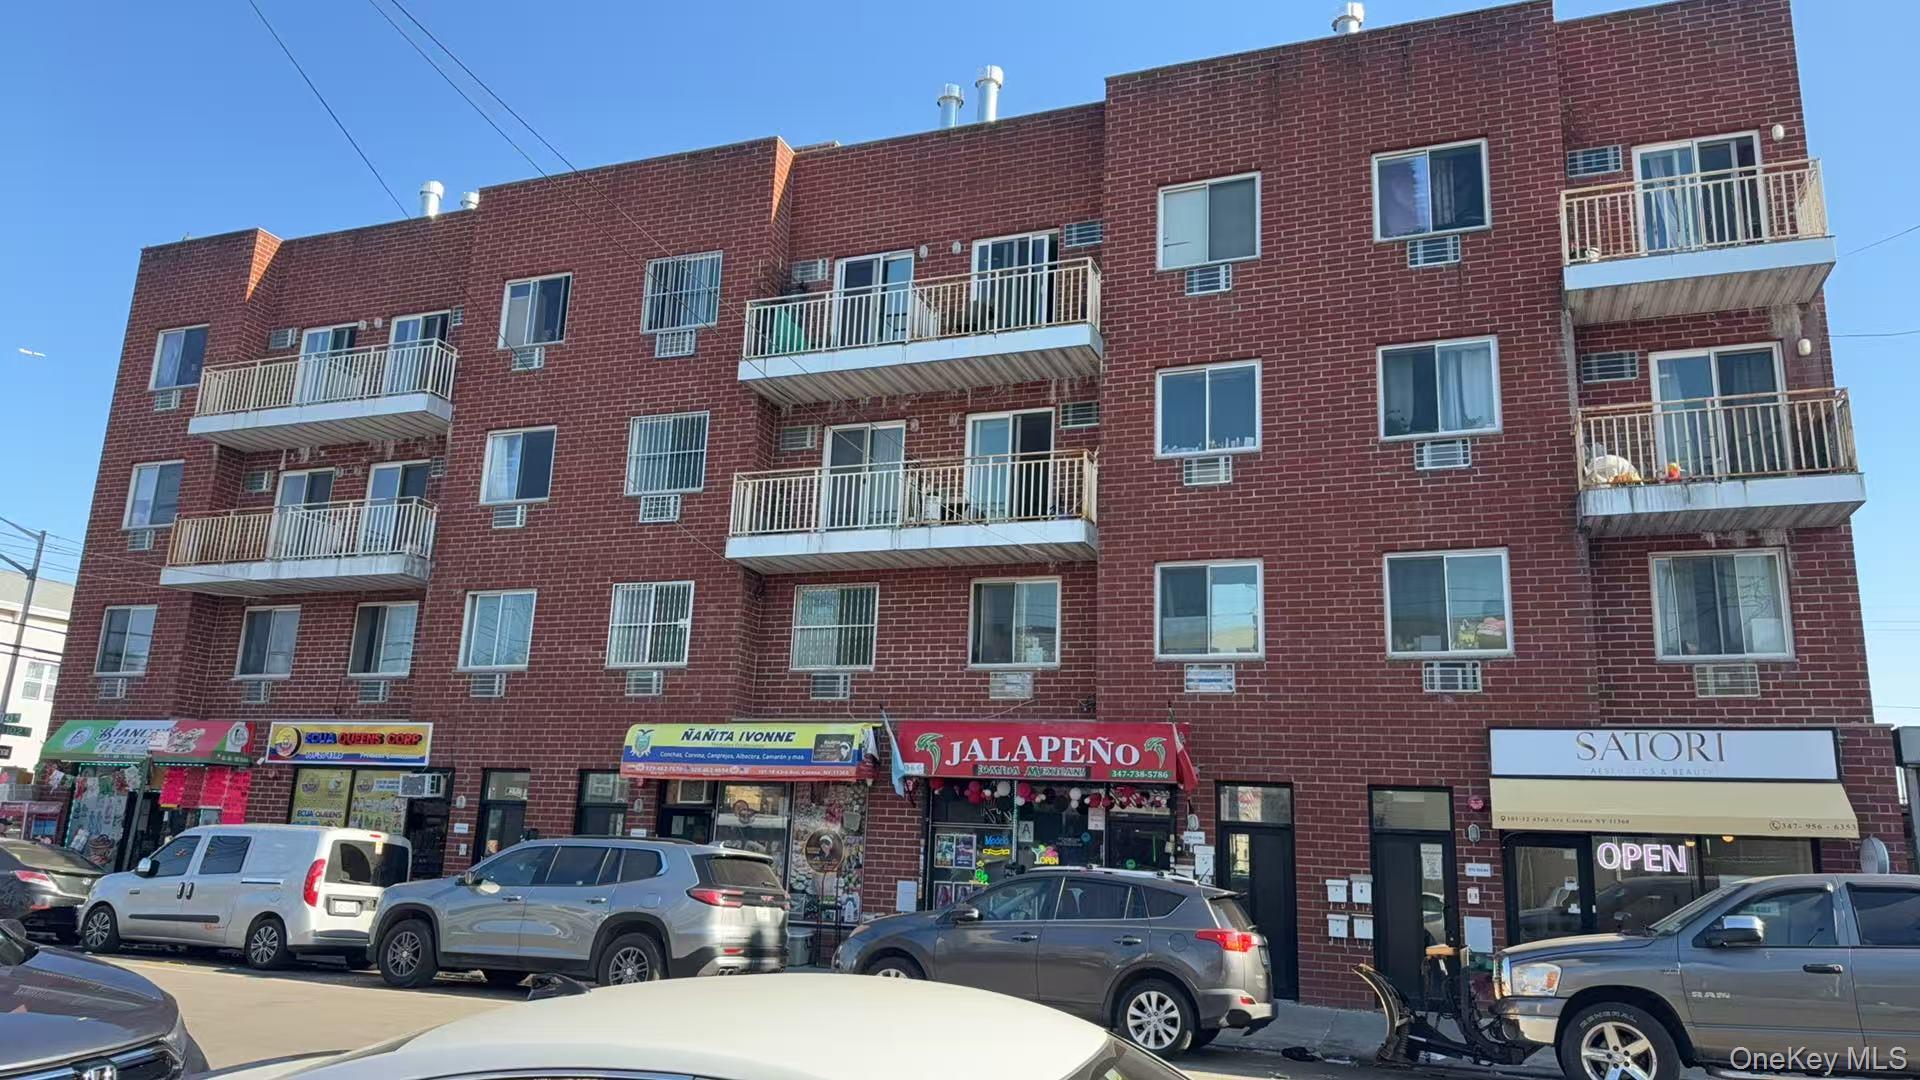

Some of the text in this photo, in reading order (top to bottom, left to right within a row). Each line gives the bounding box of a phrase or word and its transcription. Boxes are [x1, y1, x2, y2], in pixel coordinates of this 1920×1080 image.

[305, 732, 423, 745] ECUA QUEENS CORP
[681, 728, 796, 742] ÑAÑITA IVONNE
[945, 735, 1140, 766] JALAPEÑO
[1576, 731, 1725, 761] SATORI
[1111, 769, 1169, 778] 347-738-5786
[297, 809, 343, 819] ECUA QUEENS
[1023, 823, 1031, 834] A
[1040, 856, 1059, 865] OPEN
[1597, 842, 1687, 873] OPEN
[1691, 991, 1731, 999] RAM
